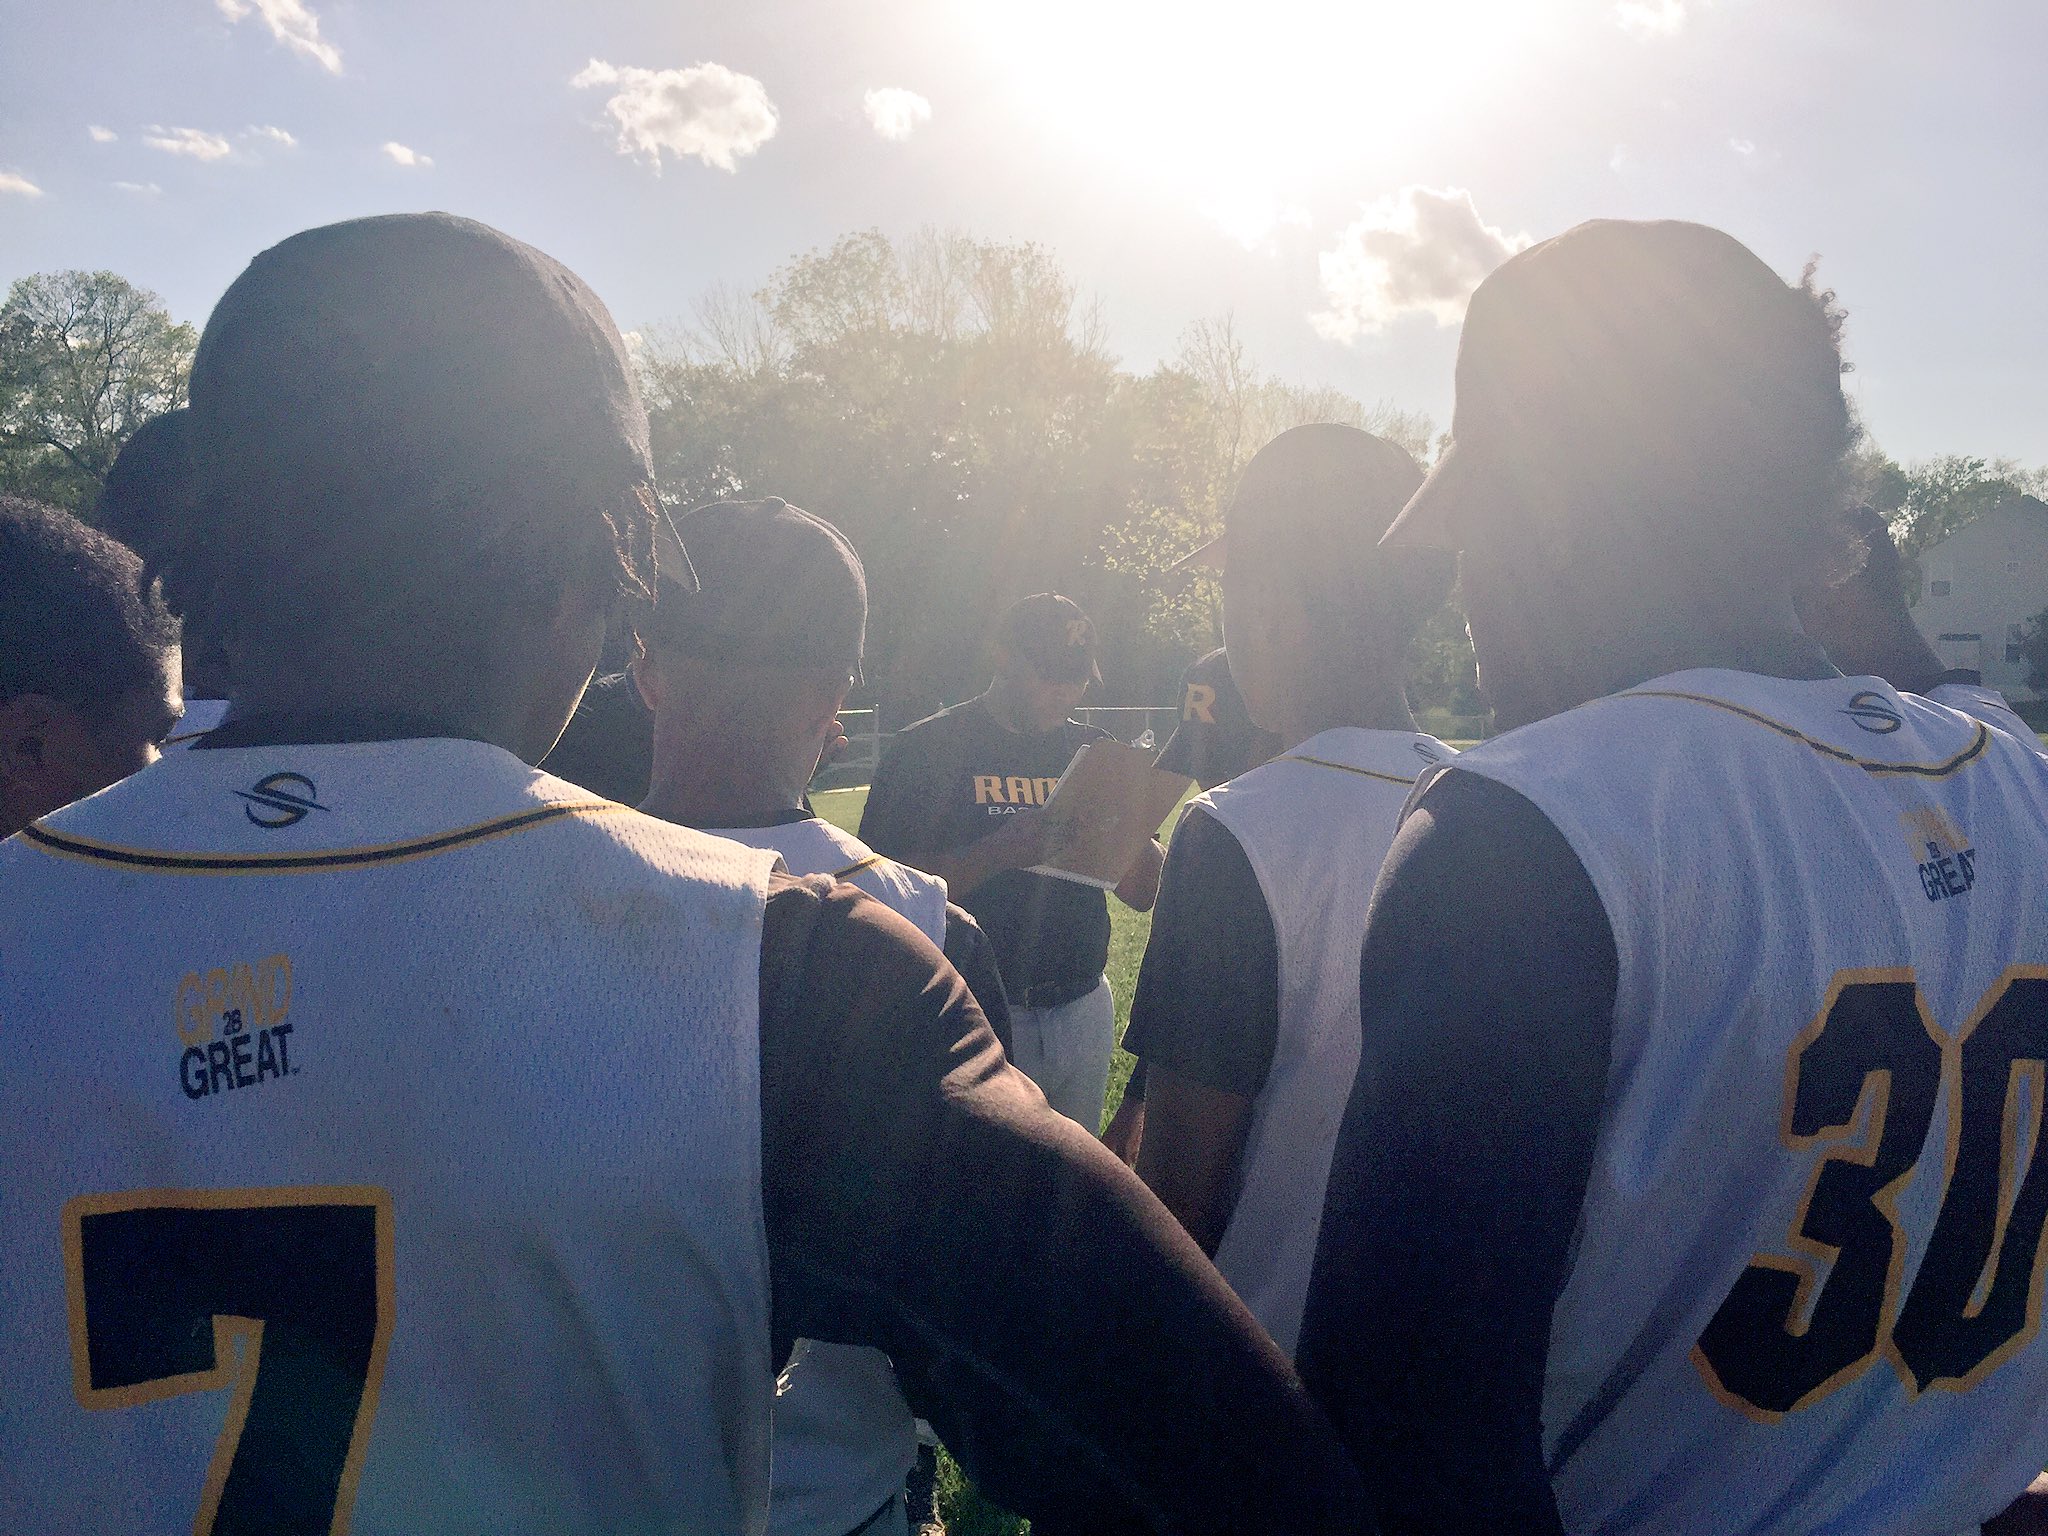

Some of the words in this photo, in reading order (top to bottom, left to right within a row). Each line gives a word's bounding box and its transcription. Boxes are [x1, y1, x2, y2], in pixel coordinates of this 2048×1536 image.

[1183, 682, 1216, 725] R
[179, 1023, 295, 1100] GREAT
[1690, 963, 2048, 1425] 30
[61, 1184, 396, 1536] 7
